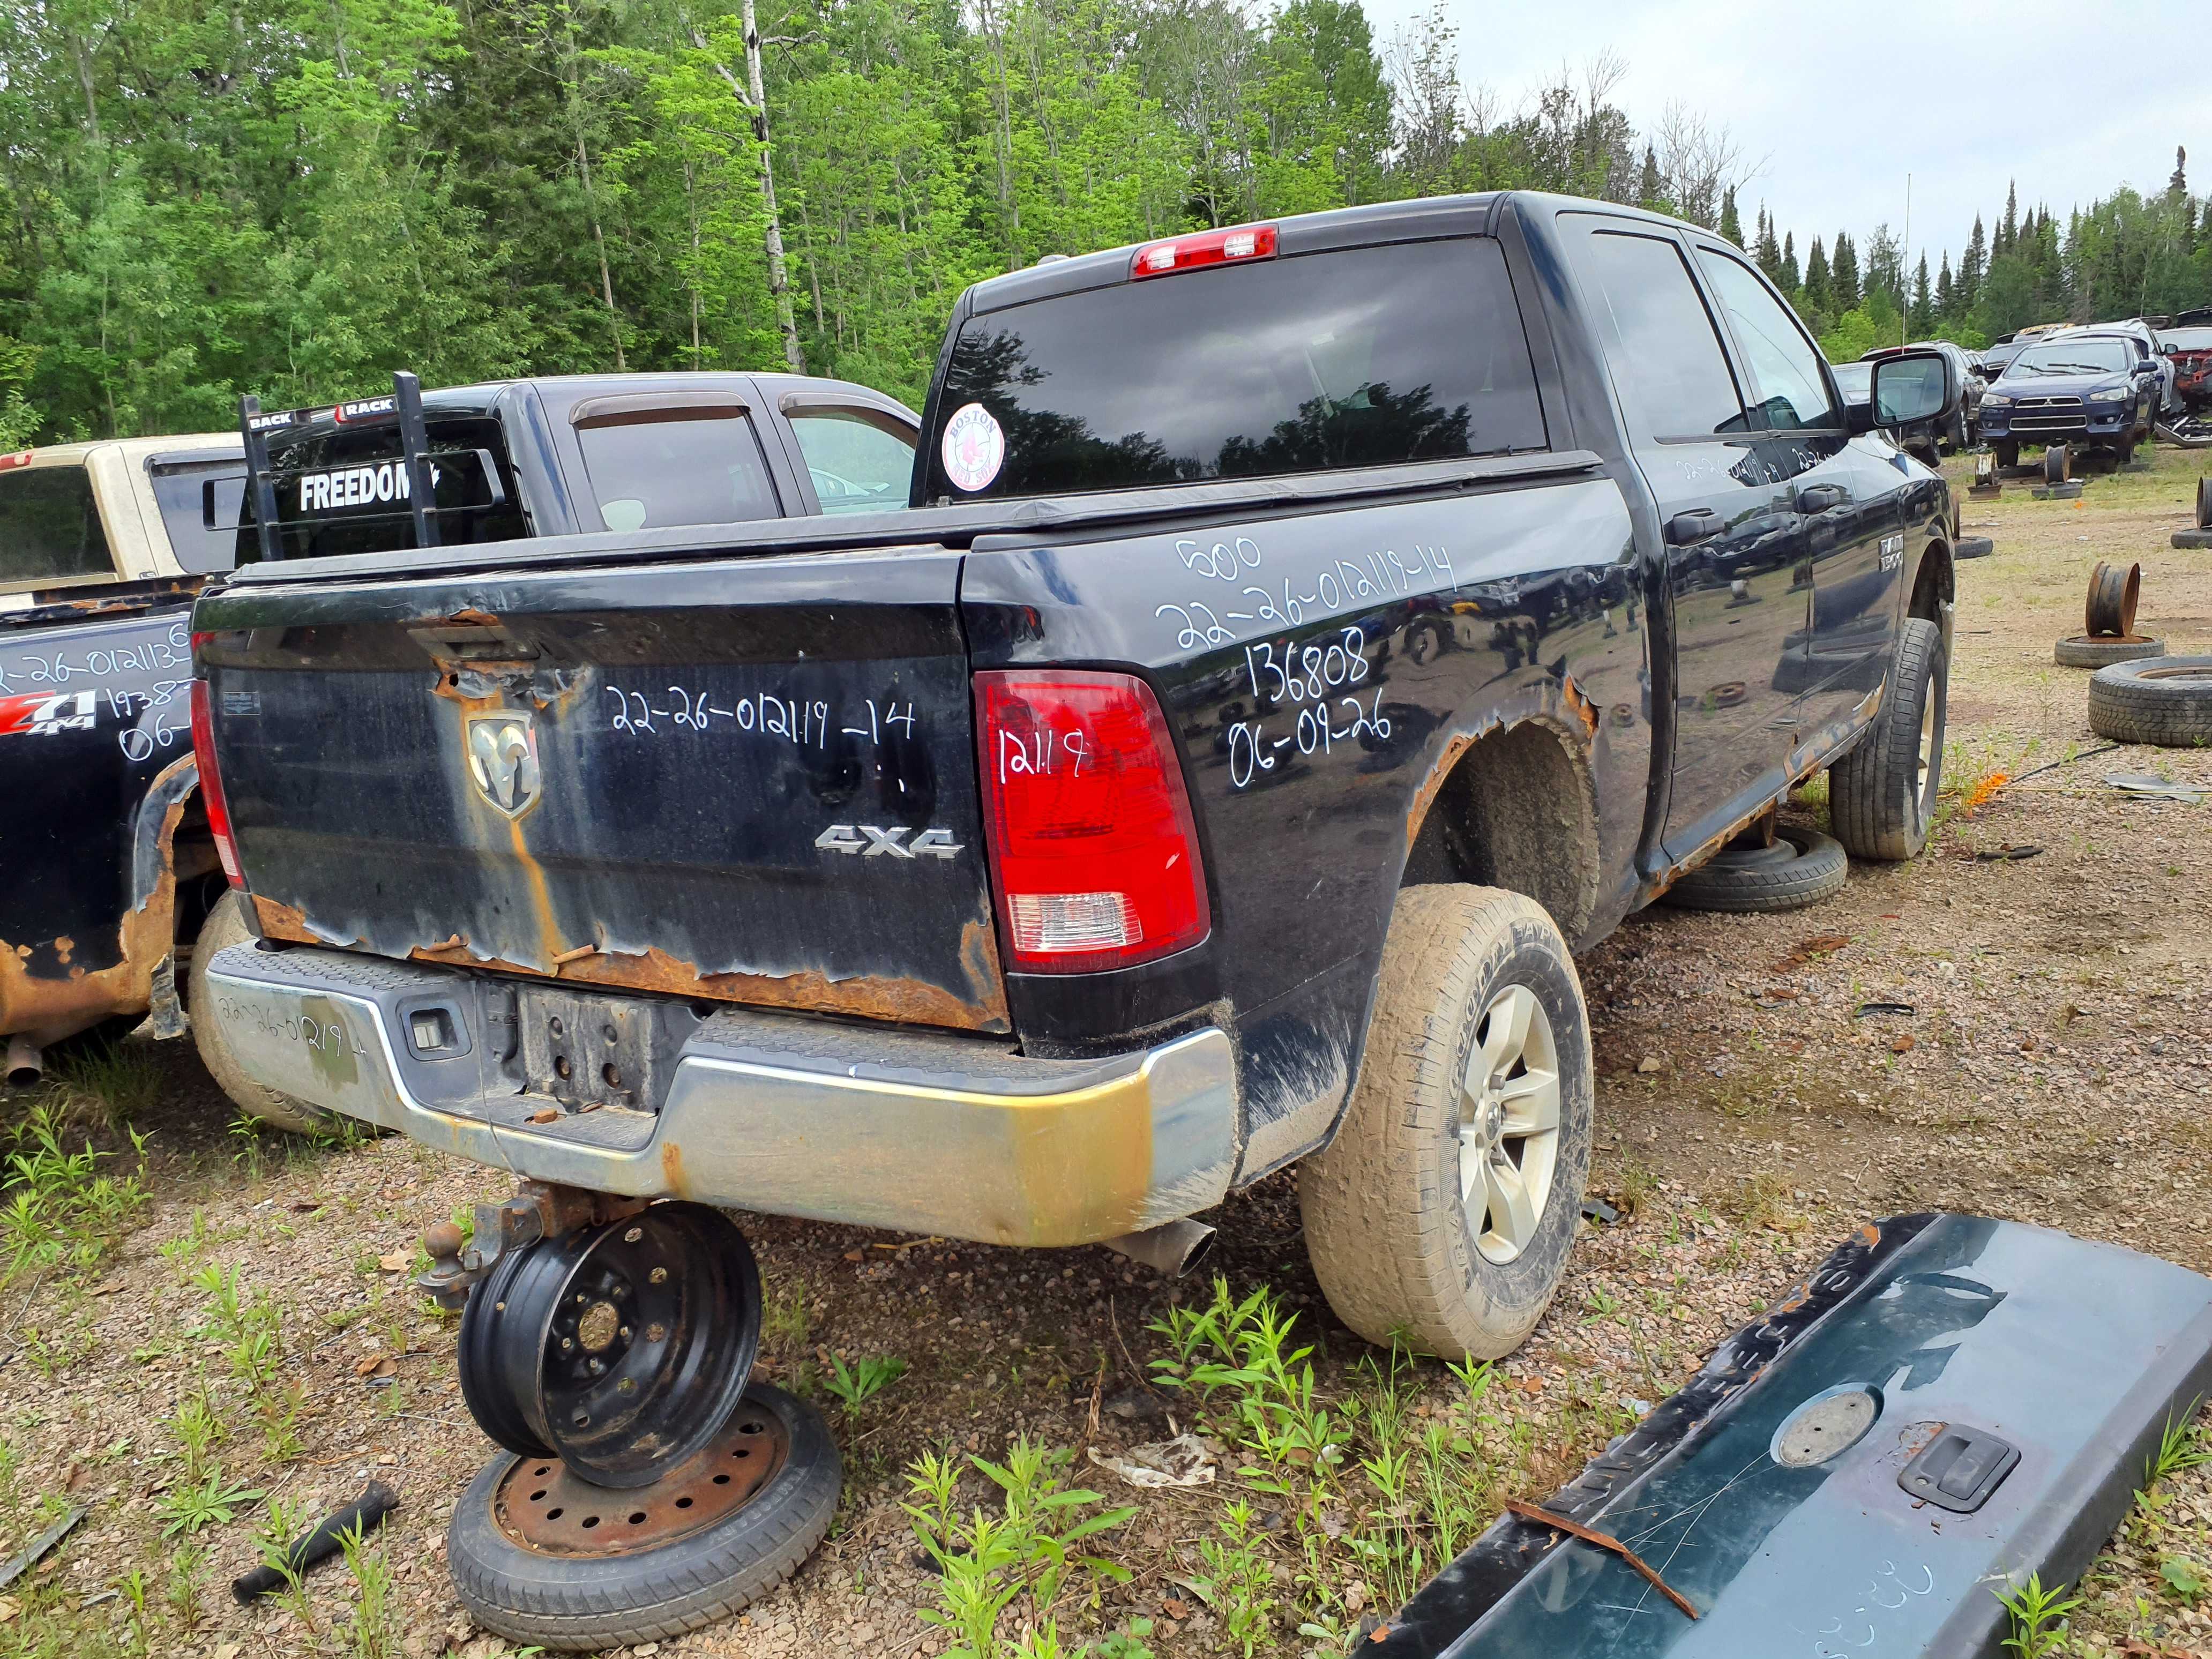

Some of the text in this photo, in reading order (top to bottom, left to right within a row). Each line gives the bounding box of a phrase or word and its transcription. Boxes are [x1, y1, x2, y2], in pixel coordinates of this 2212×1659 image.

[249, 399, 393, 429] BACK RACK
[950, 410, 997, 439] BOSTON
[952, 458, 996, 484] RED SOX
[1175, 537, 1261, 581] 500
[1245, 626, 1369, 701] 136808
[1229, 687, 1391, 788] 06-09-26
